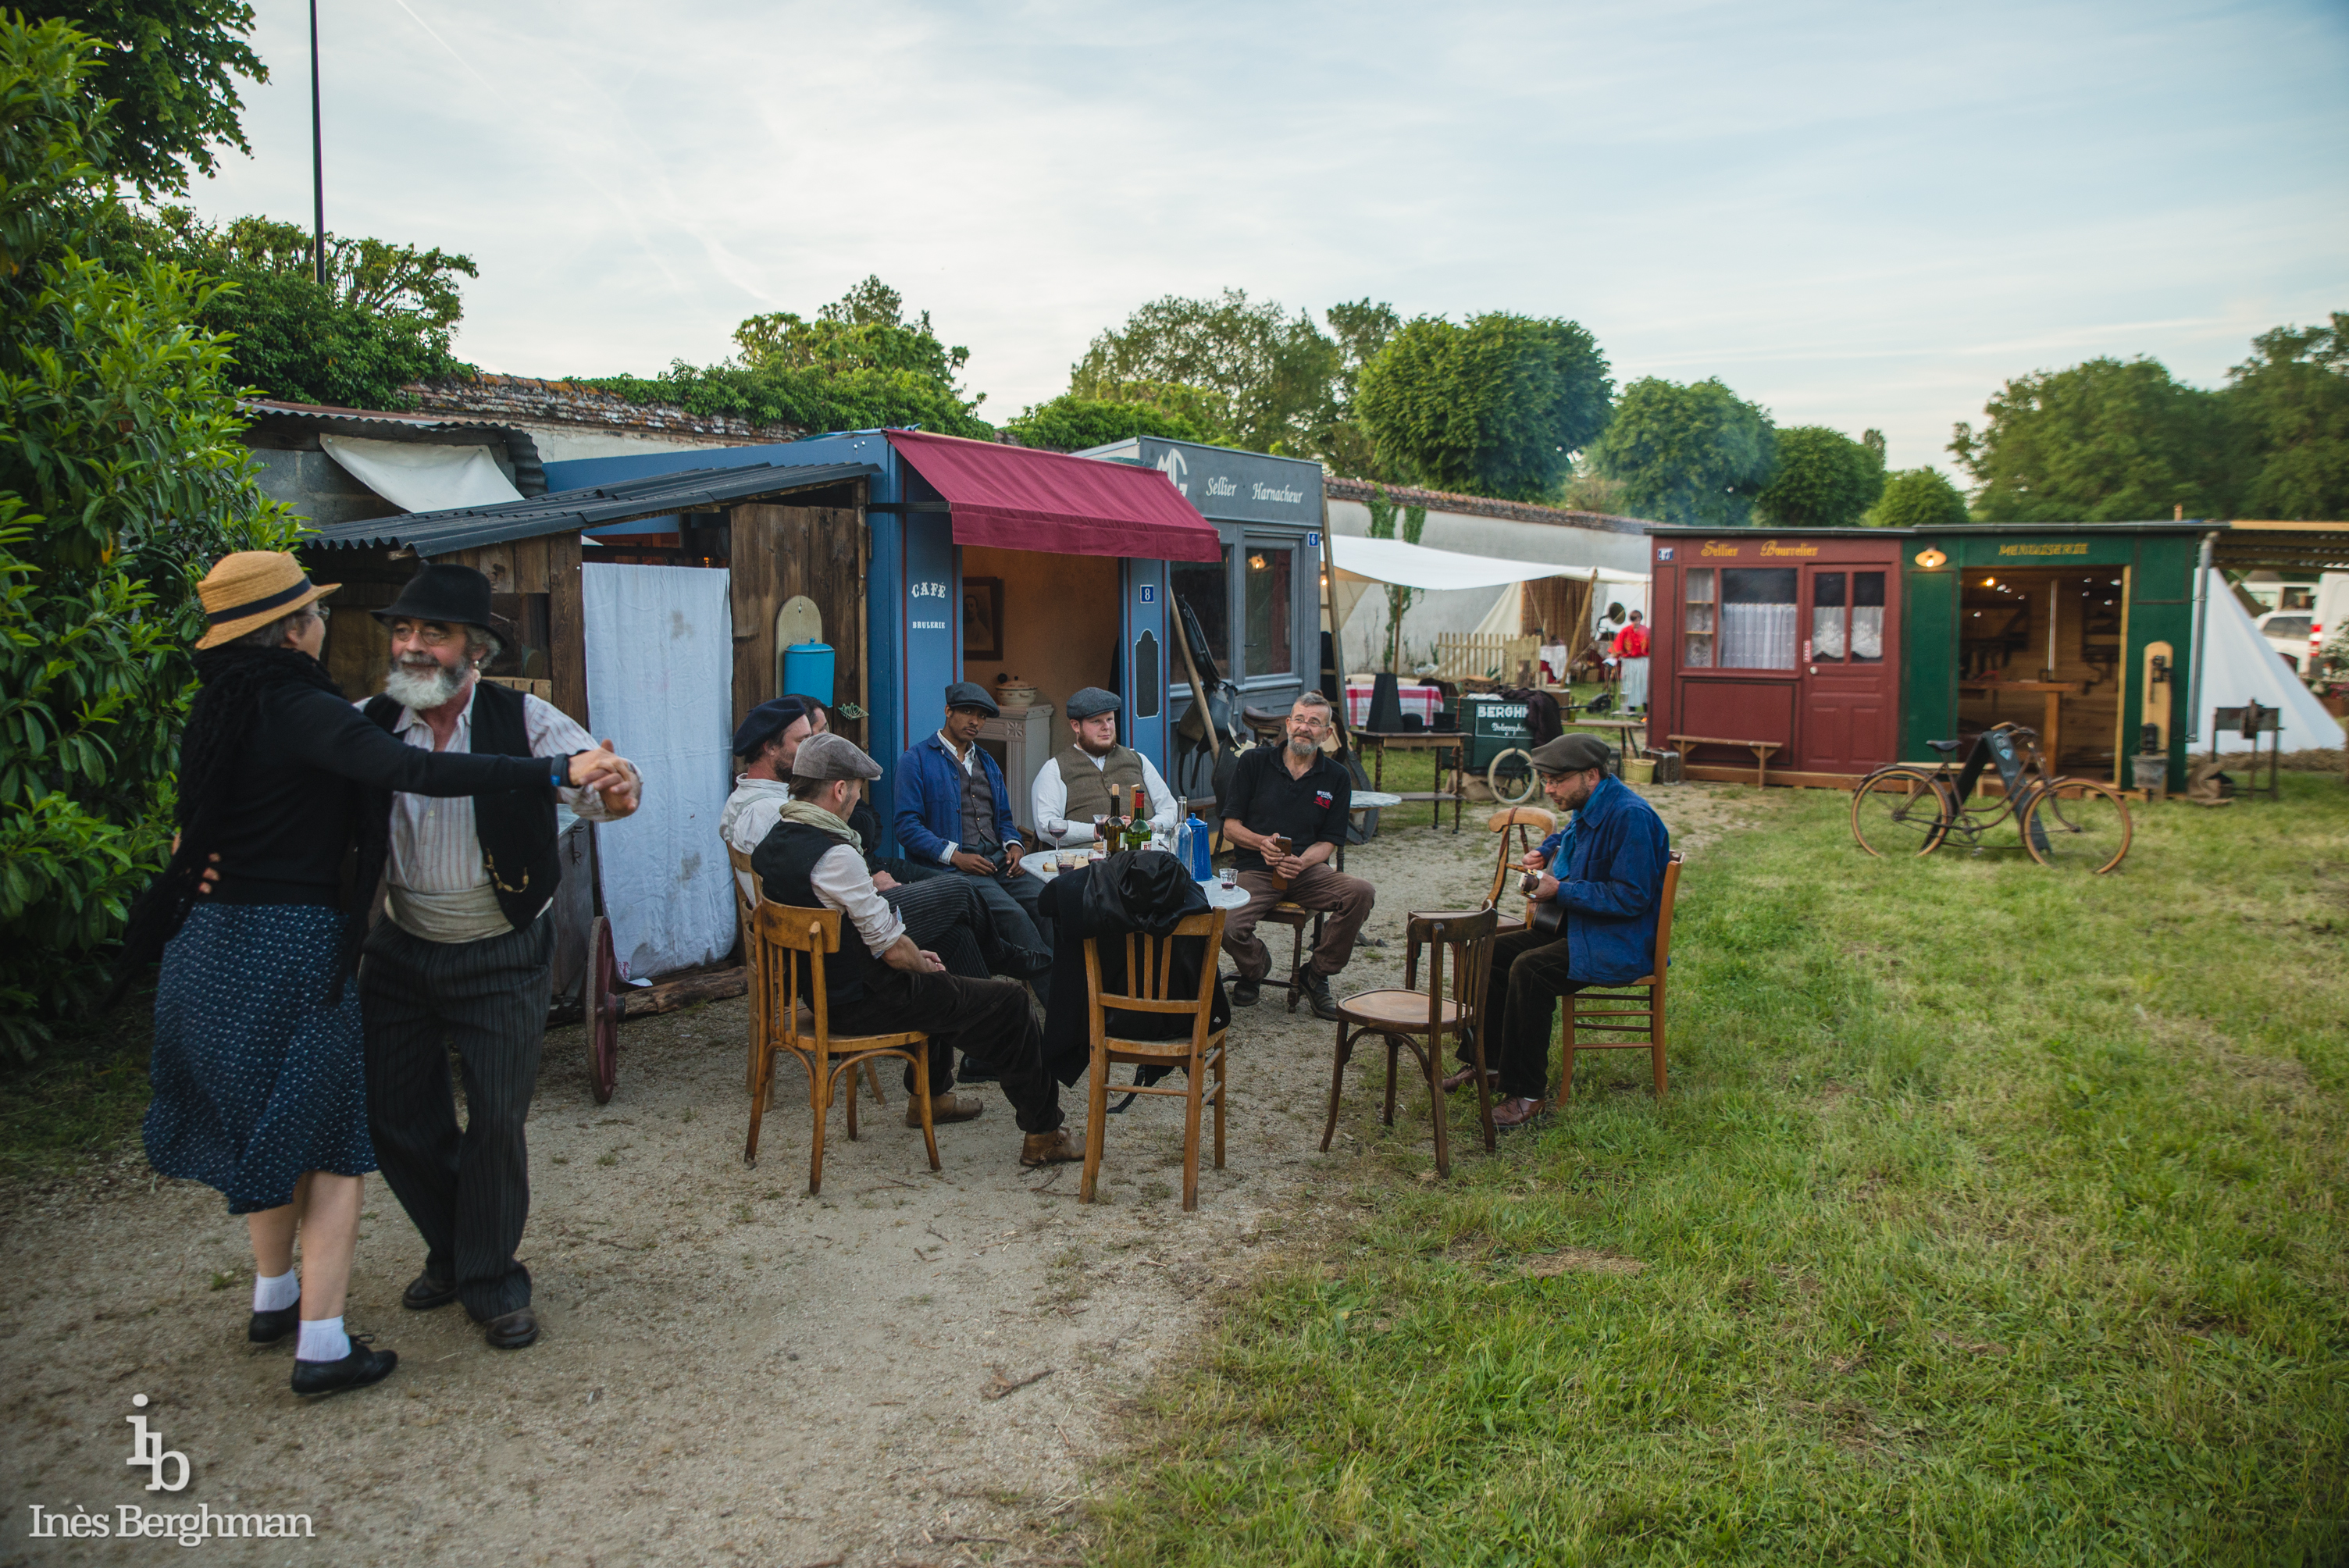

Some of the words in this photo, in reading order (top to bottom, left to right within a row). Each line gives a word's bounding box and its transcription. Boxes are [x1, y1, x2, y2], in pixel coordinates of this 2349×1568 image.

[1206, 476, 1237, 497] Sellier
[1252, 482, 1303, 504] Harnacheur
[1658, 549, 1672, 561] 47
[1701, 540, 1739, 557] Sellier
[1760, 540, 1820, 557] Bourrelier
[911, 582, 946, 599] CAFÉ
[912, 621, 946, 629] BRULERIE
